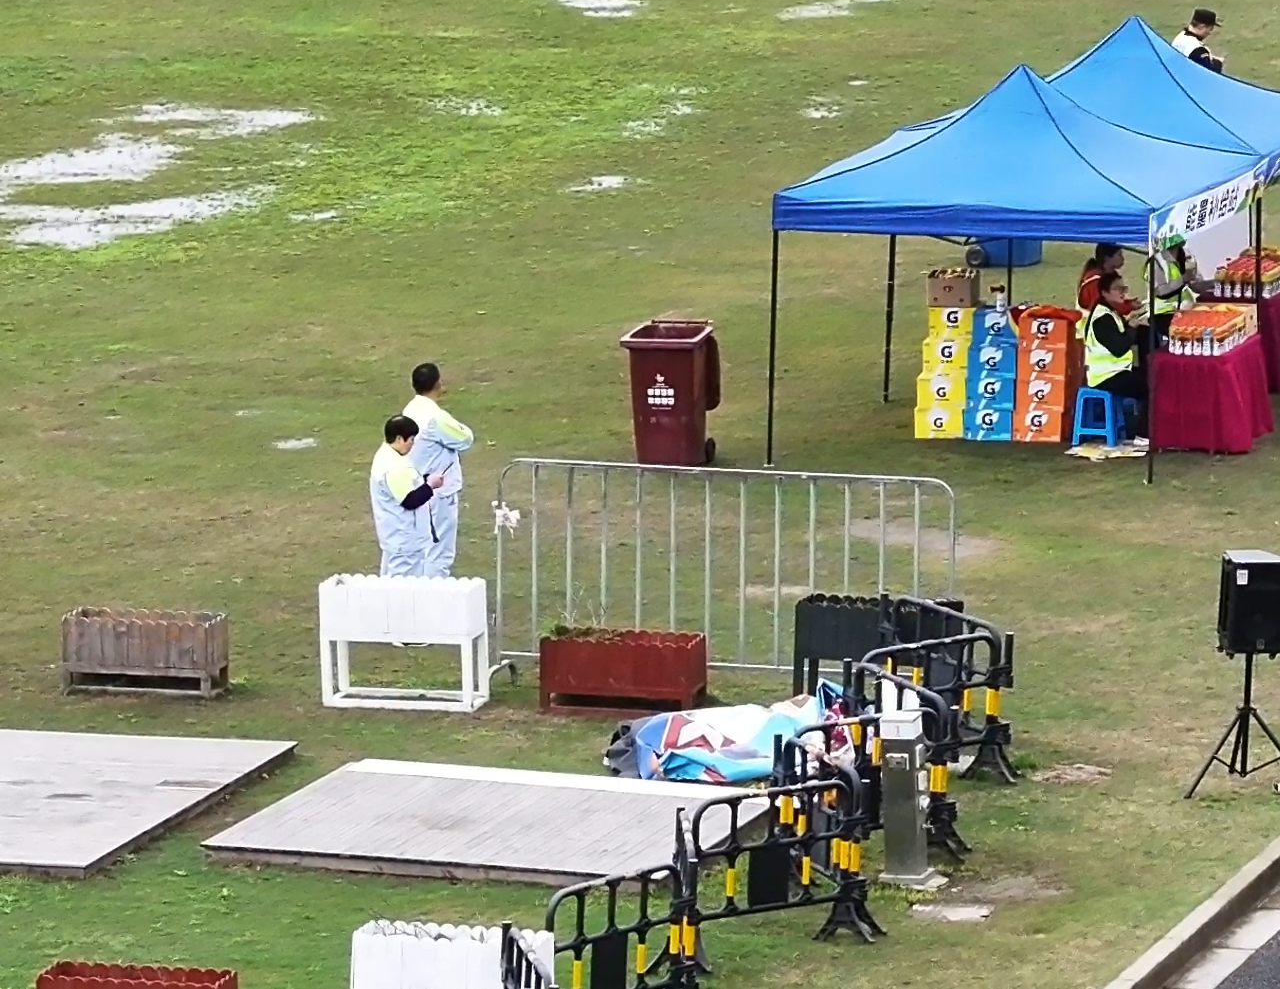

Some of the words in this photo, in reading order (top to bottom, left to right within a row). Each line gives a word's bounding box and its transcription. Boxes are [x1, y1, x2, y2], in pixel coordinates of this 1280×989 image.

[946, 311, 959, 324] G
[990, 322, 1001, 333] G
[1036, 321, 1049, 335] G
[940, 345, 953, 359] G
[986, 357, 997, 368] G
[1036, 358, 1046, 370] G
[936, 387, 947, 398] G
[983, 381, 996, 395] G
[1034, 389, 1045, 400] G
[933, 417, 944, 428] G
[981, 412, 993, 426] G
[1030, 414, 1042, 427] G
